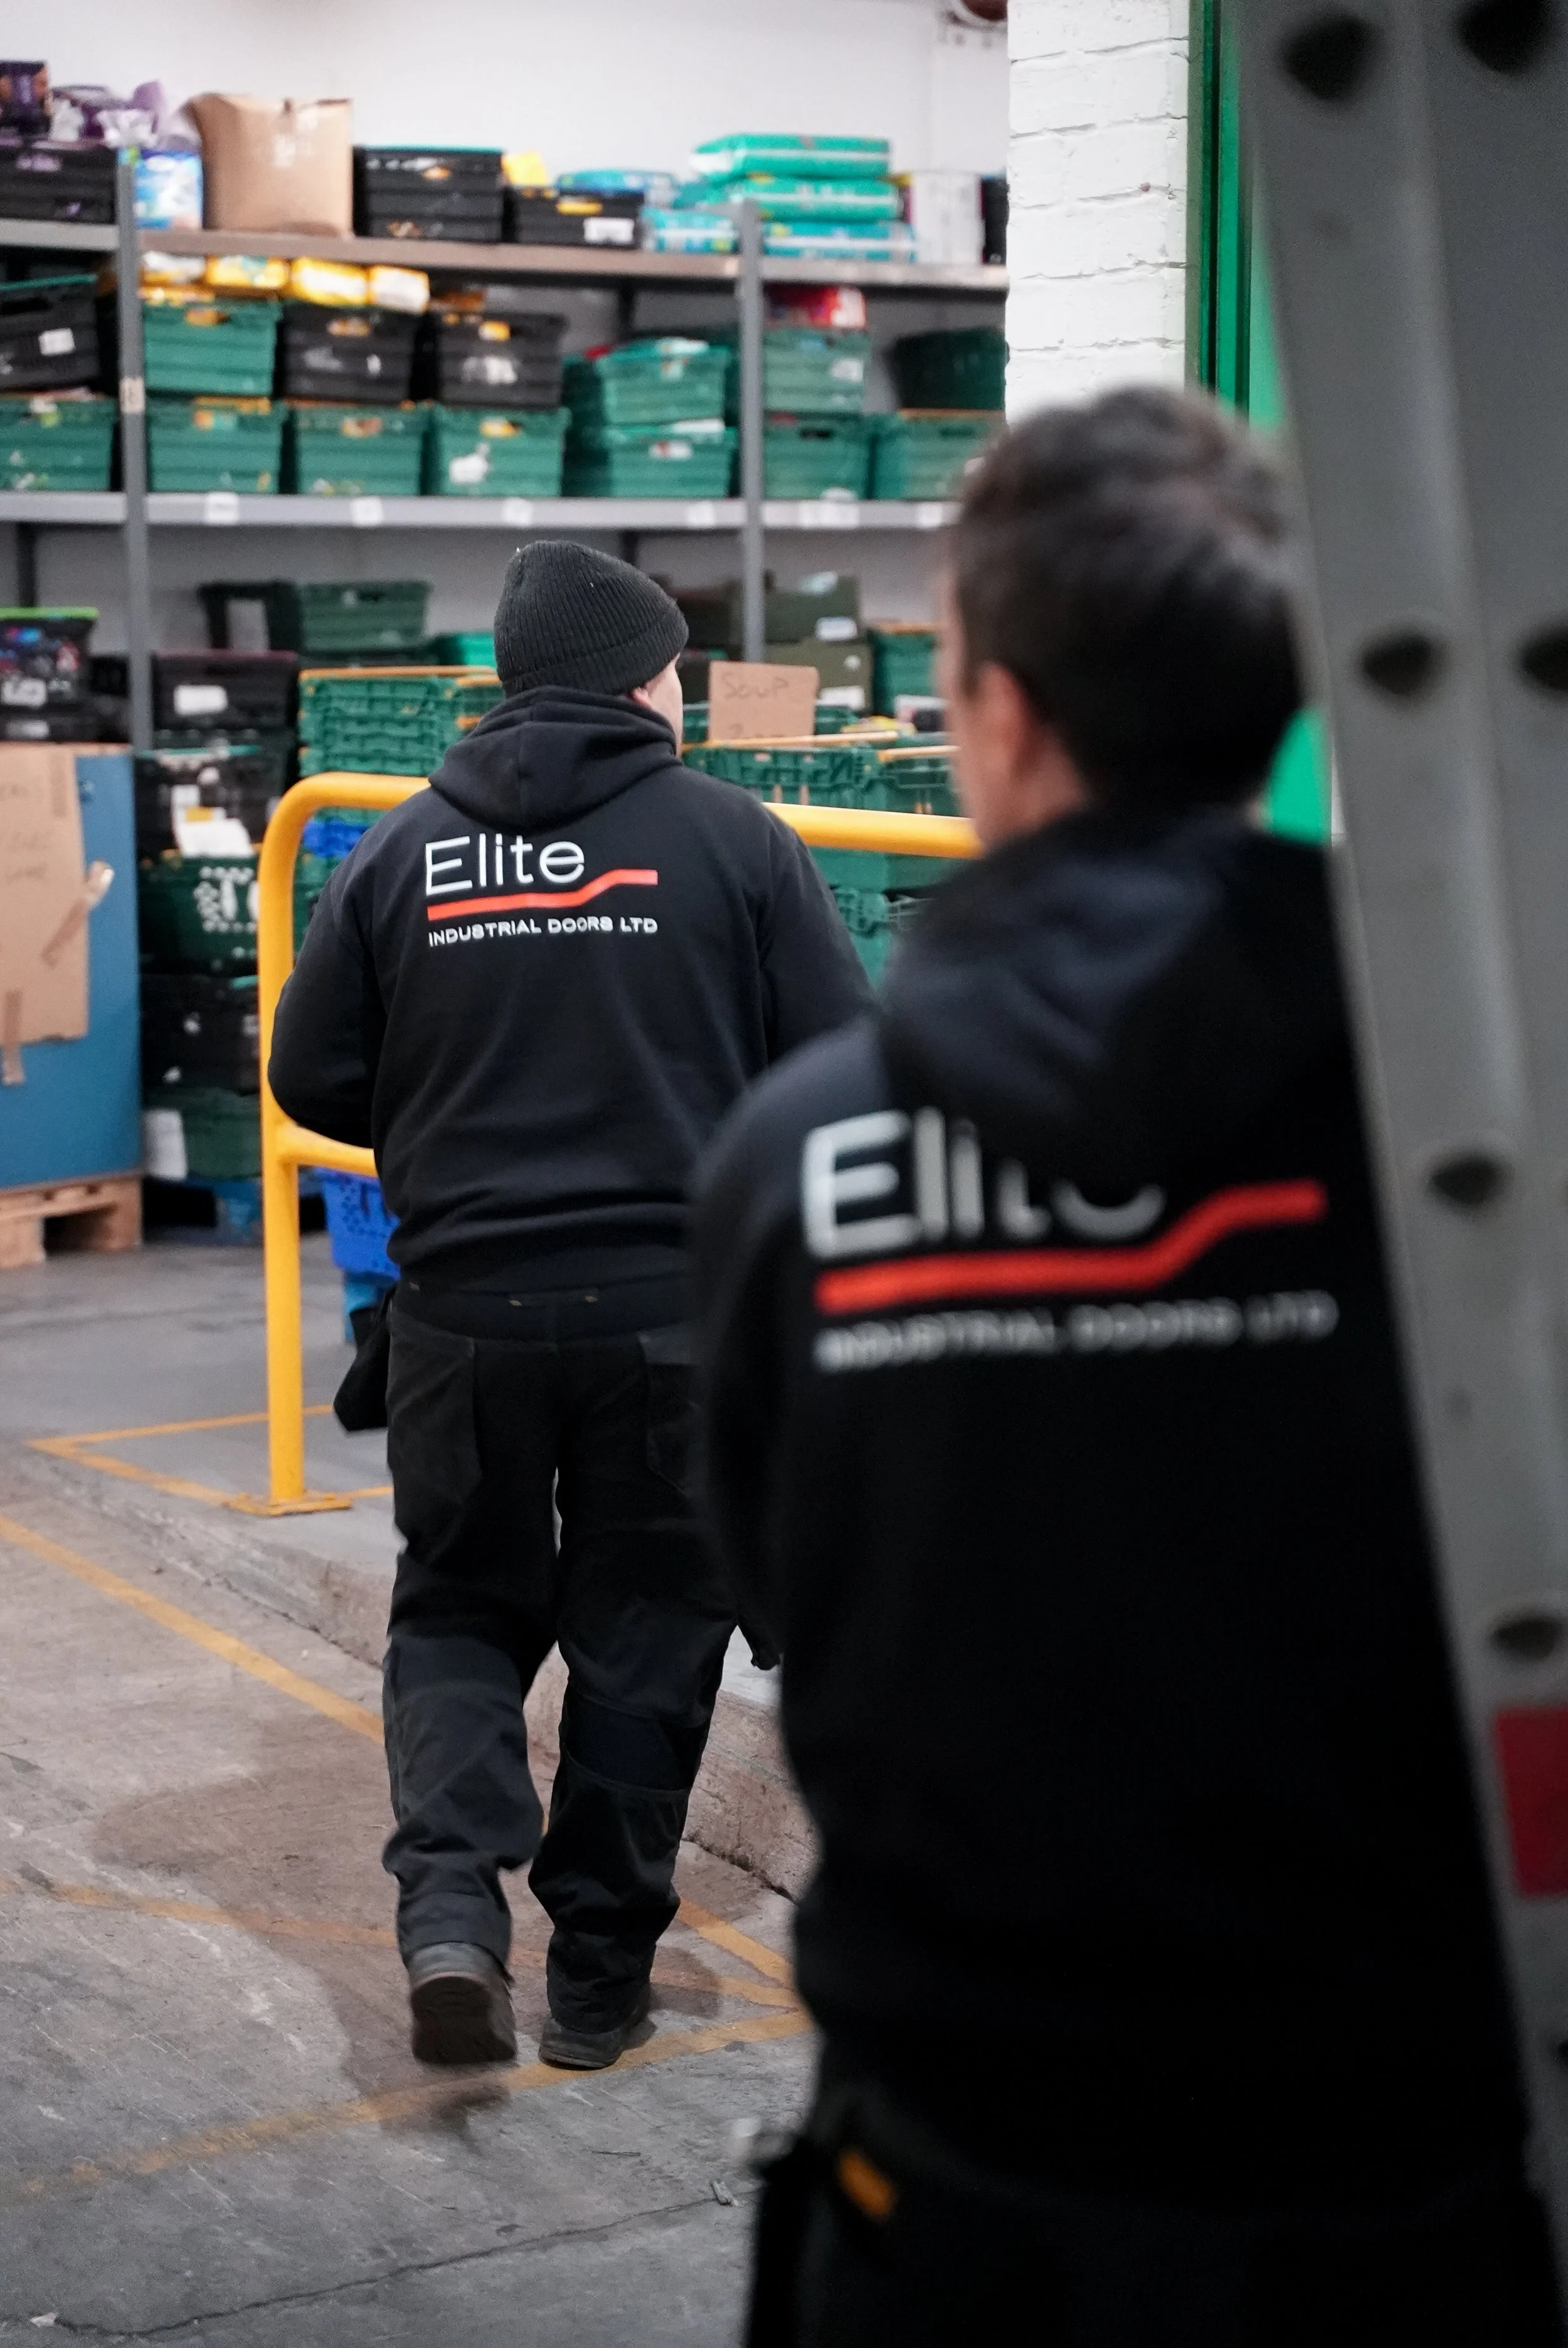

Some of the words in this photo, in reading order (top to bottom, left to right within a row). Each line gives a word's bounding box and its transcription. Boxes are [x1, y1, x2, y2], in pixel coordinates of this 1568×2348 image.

[426, 833, 585, 896] Elite
[428, 918, 541, 947] INDUSTRIAL
[548, 916, 613, 934] DOORS
[620, 916, 658, 934] LTD
